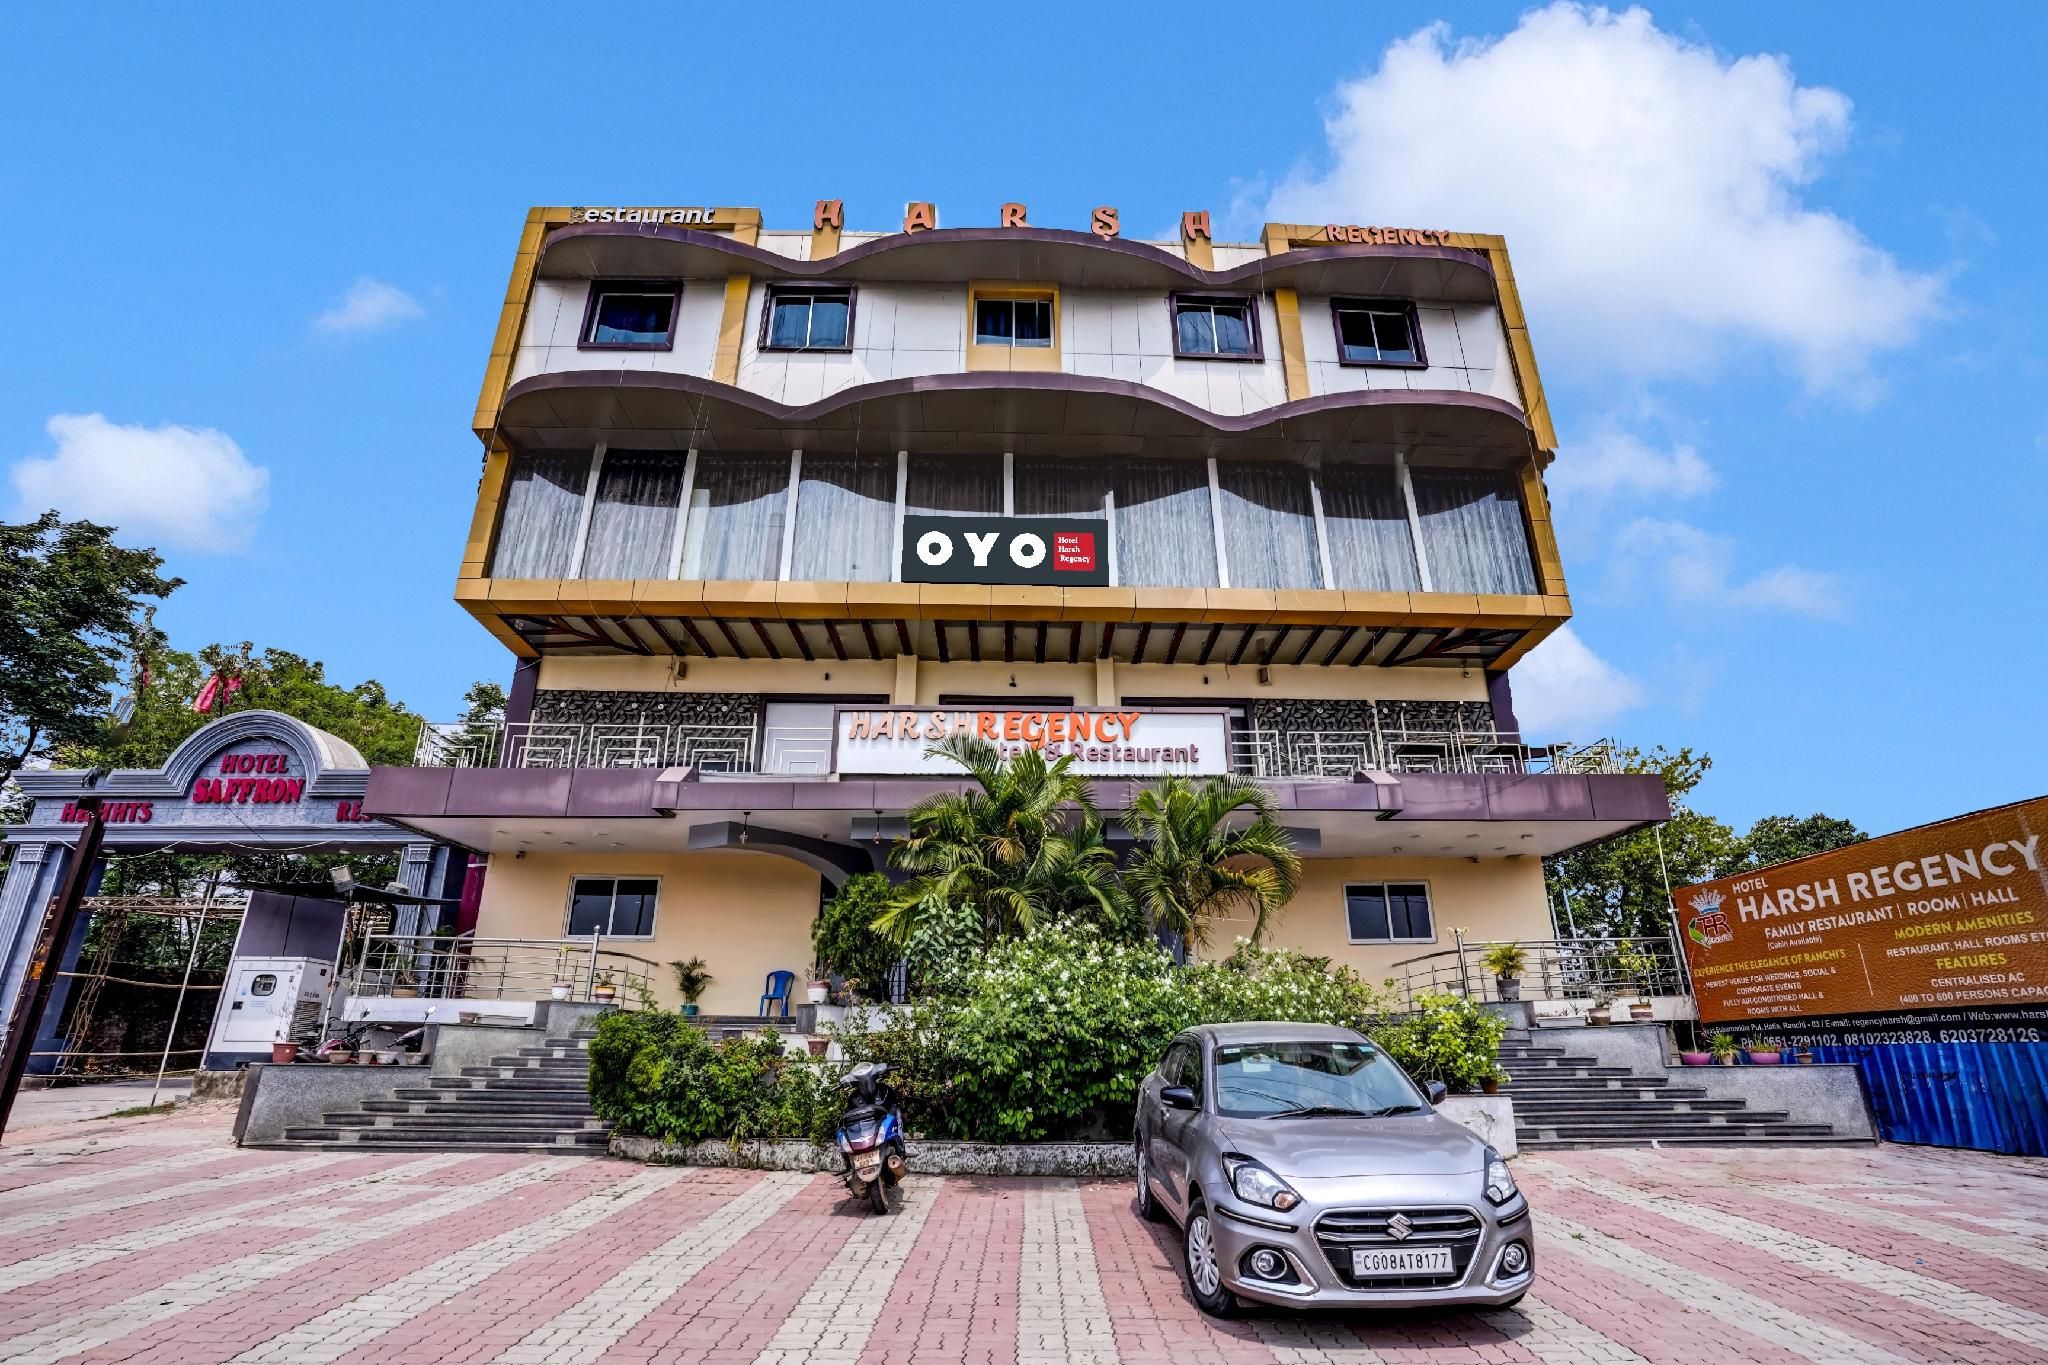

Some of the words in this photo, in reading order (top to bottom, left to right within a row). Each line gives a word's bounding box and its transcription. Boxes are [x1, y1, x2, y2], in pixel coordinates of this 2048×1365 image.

[1325, 223, 1449, 247] REGENCY
[1057, 536, 1078, 544] Hotel
[1057, 545, 1081, 553] Harsh
[916, 530, 1047, 569] OYO
[1060, 554, 1091, 564] Regency
[849, 711, 971, 741] HARSH
[976, 711, 1142, 751] REGENCY
[1044, 742, 1064, 762] &
[1070, 741, 1200, 764] Restaurant
[219, 753, 289, 774] HOTEL
[192, 778, 306, 804] SAFFRON
[1732, 876, 1769, 894] HOTEL
[1736, 877, 1841, 923] HARSH
[1846, 834, 2041, 902] REGENCY
[1764, 921, 1805, 939] FAMILY
[1807, 906, 1893, 933] RESTAURANT
[1906, 895, 1961, 916] ROOM
[1970, 886, 2019, 907] HALL
[1894, 922, 1953, 940] MODERN
[1955, 911, 2036, 932] AMENITIES
[1767, 941, 1789, 951] (Cabin
[1886, 943, 1954, 958] RESTAURANT,
[1955, 939, 1984, 952] HALL
[1984, 934, 2029, 947] ROOMS
[1693, 963, 1735, 978] EXPERIENCE
[1735, 961, 1750, 971] THE
[1750, 956, 1791, 969] ELEGANCE
[1791, 953, 1803, 964] OF
[1803, 949, 1846, 963] RANCHI'S
[1935, 953, 2008, 970] FEATURES
[1750, 974, 1764, 984] FOR
[1802, 967, 1830, 977] SOCIAL
[1830, 966, 1837, 974] &
[1931, 973, 2006, 988] CENTRALISED
[2008, 972, 2025, 983] AC
[1736, 984, 1775, 995] CORPORATE
[1775, 982, 1802, 992] EVENTS
[1899, 995, 1919, 1005] (400
[1921, 993, 1935, 1003] TO
[1955, 988, 2009, 1001] PERSONS
[1747, 1006, 1770, 1015] ROOMS
[1771, 1005, 1788, 1013] WITH
[1852, 1011, 1961, 1028] regencyharsh@gmail.com
[1939, 1027, 2041, 1044] 6203728126
[1363, 1252, 1448, 1271] CG08AT8177
